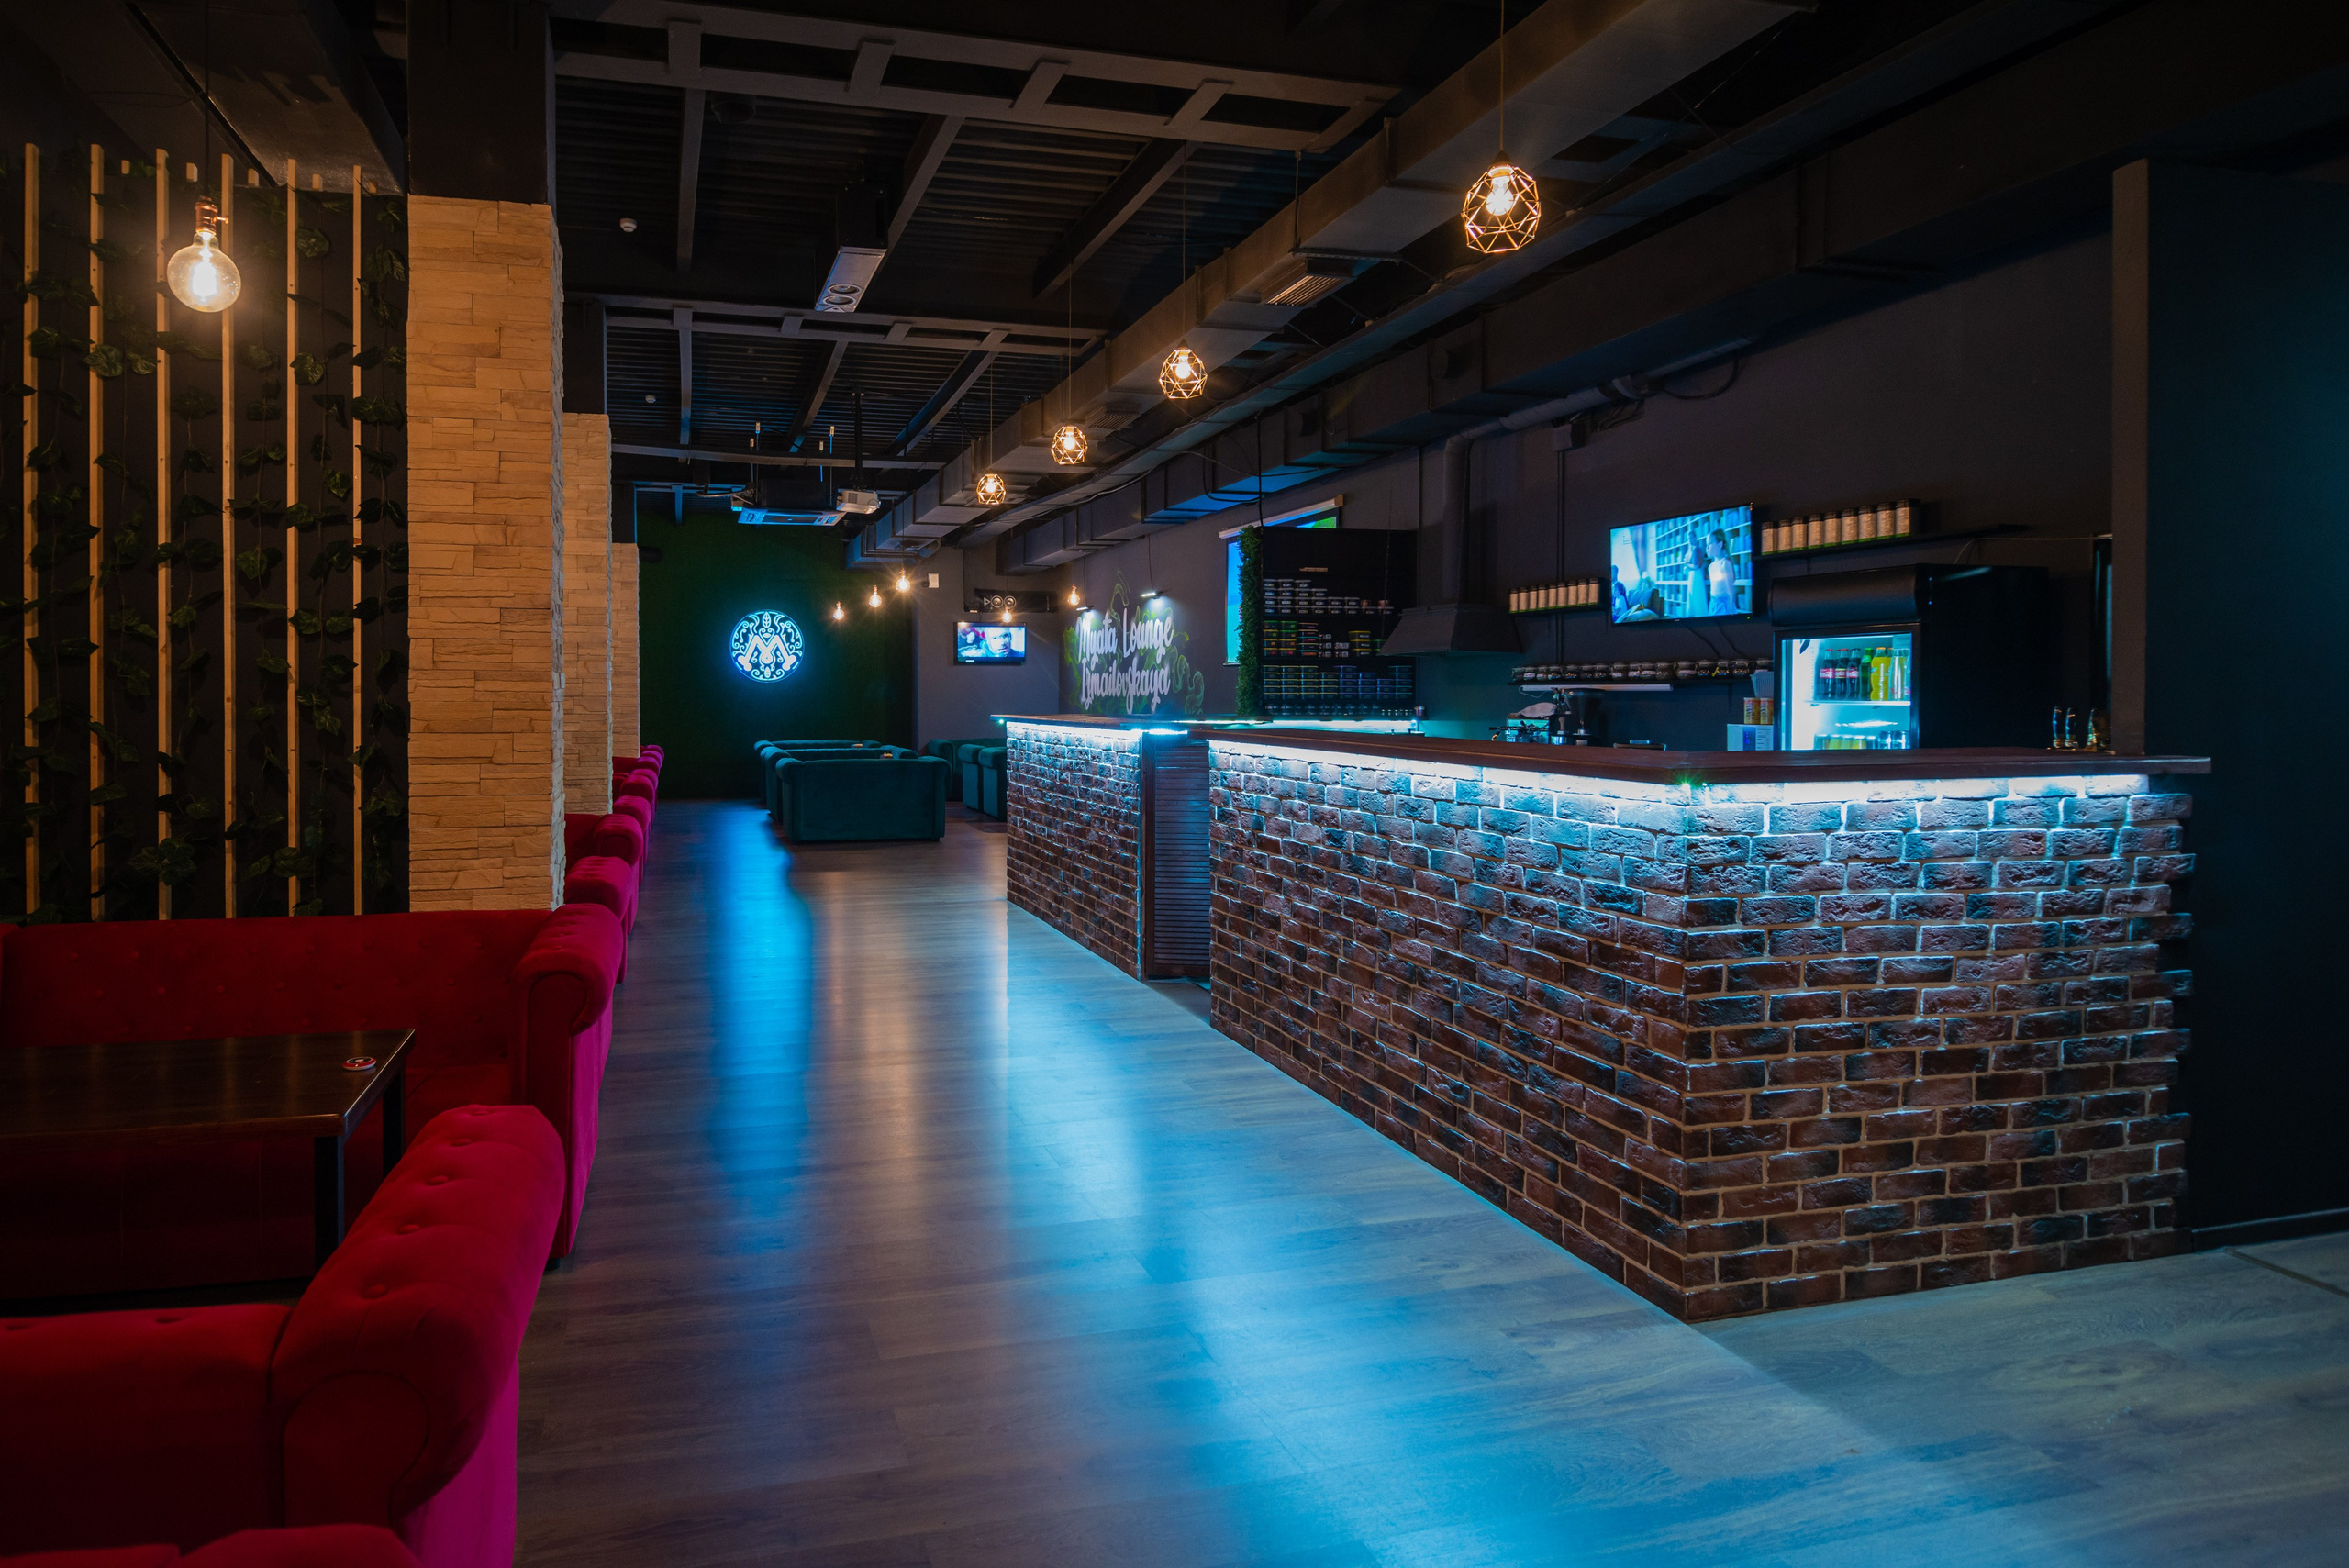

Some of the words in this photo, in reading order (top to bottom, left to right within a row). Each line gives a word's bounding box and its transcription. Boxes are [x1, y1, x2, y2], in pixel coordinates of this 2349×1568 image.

[1075, 609, 1118, 671] Myata
[1122, 607, 1174, 663] Lounge
[1081, 656, 1171, 715] Izmailovskaya
